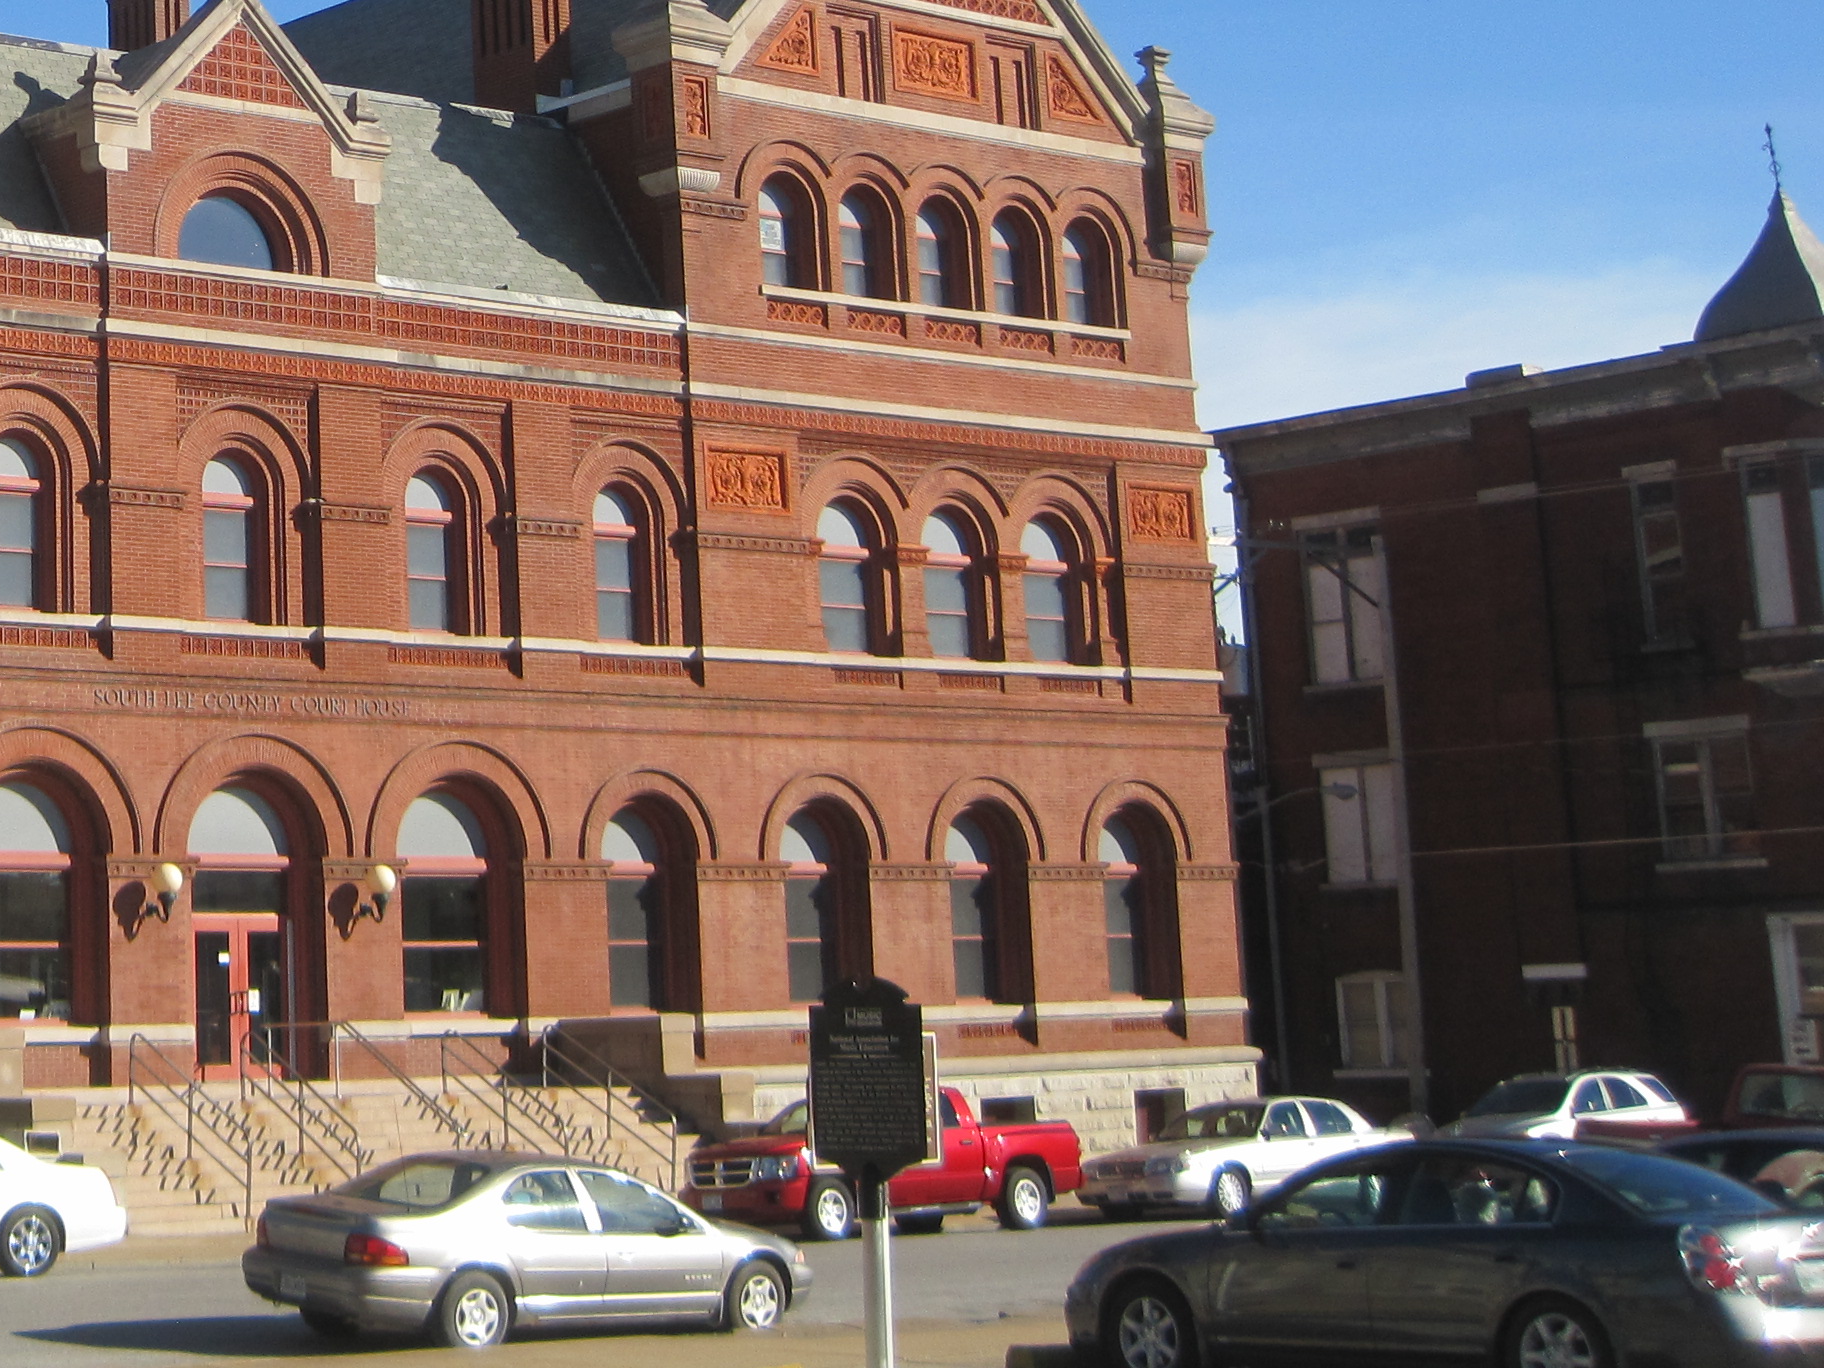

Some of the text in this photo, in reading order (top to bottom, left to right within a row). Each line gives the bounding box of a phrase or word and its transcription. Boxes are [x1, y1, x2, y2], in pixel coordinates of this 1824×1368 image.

[93, 688, 410, 717] SOUTH LEE COUNTY COURT HOUSE
